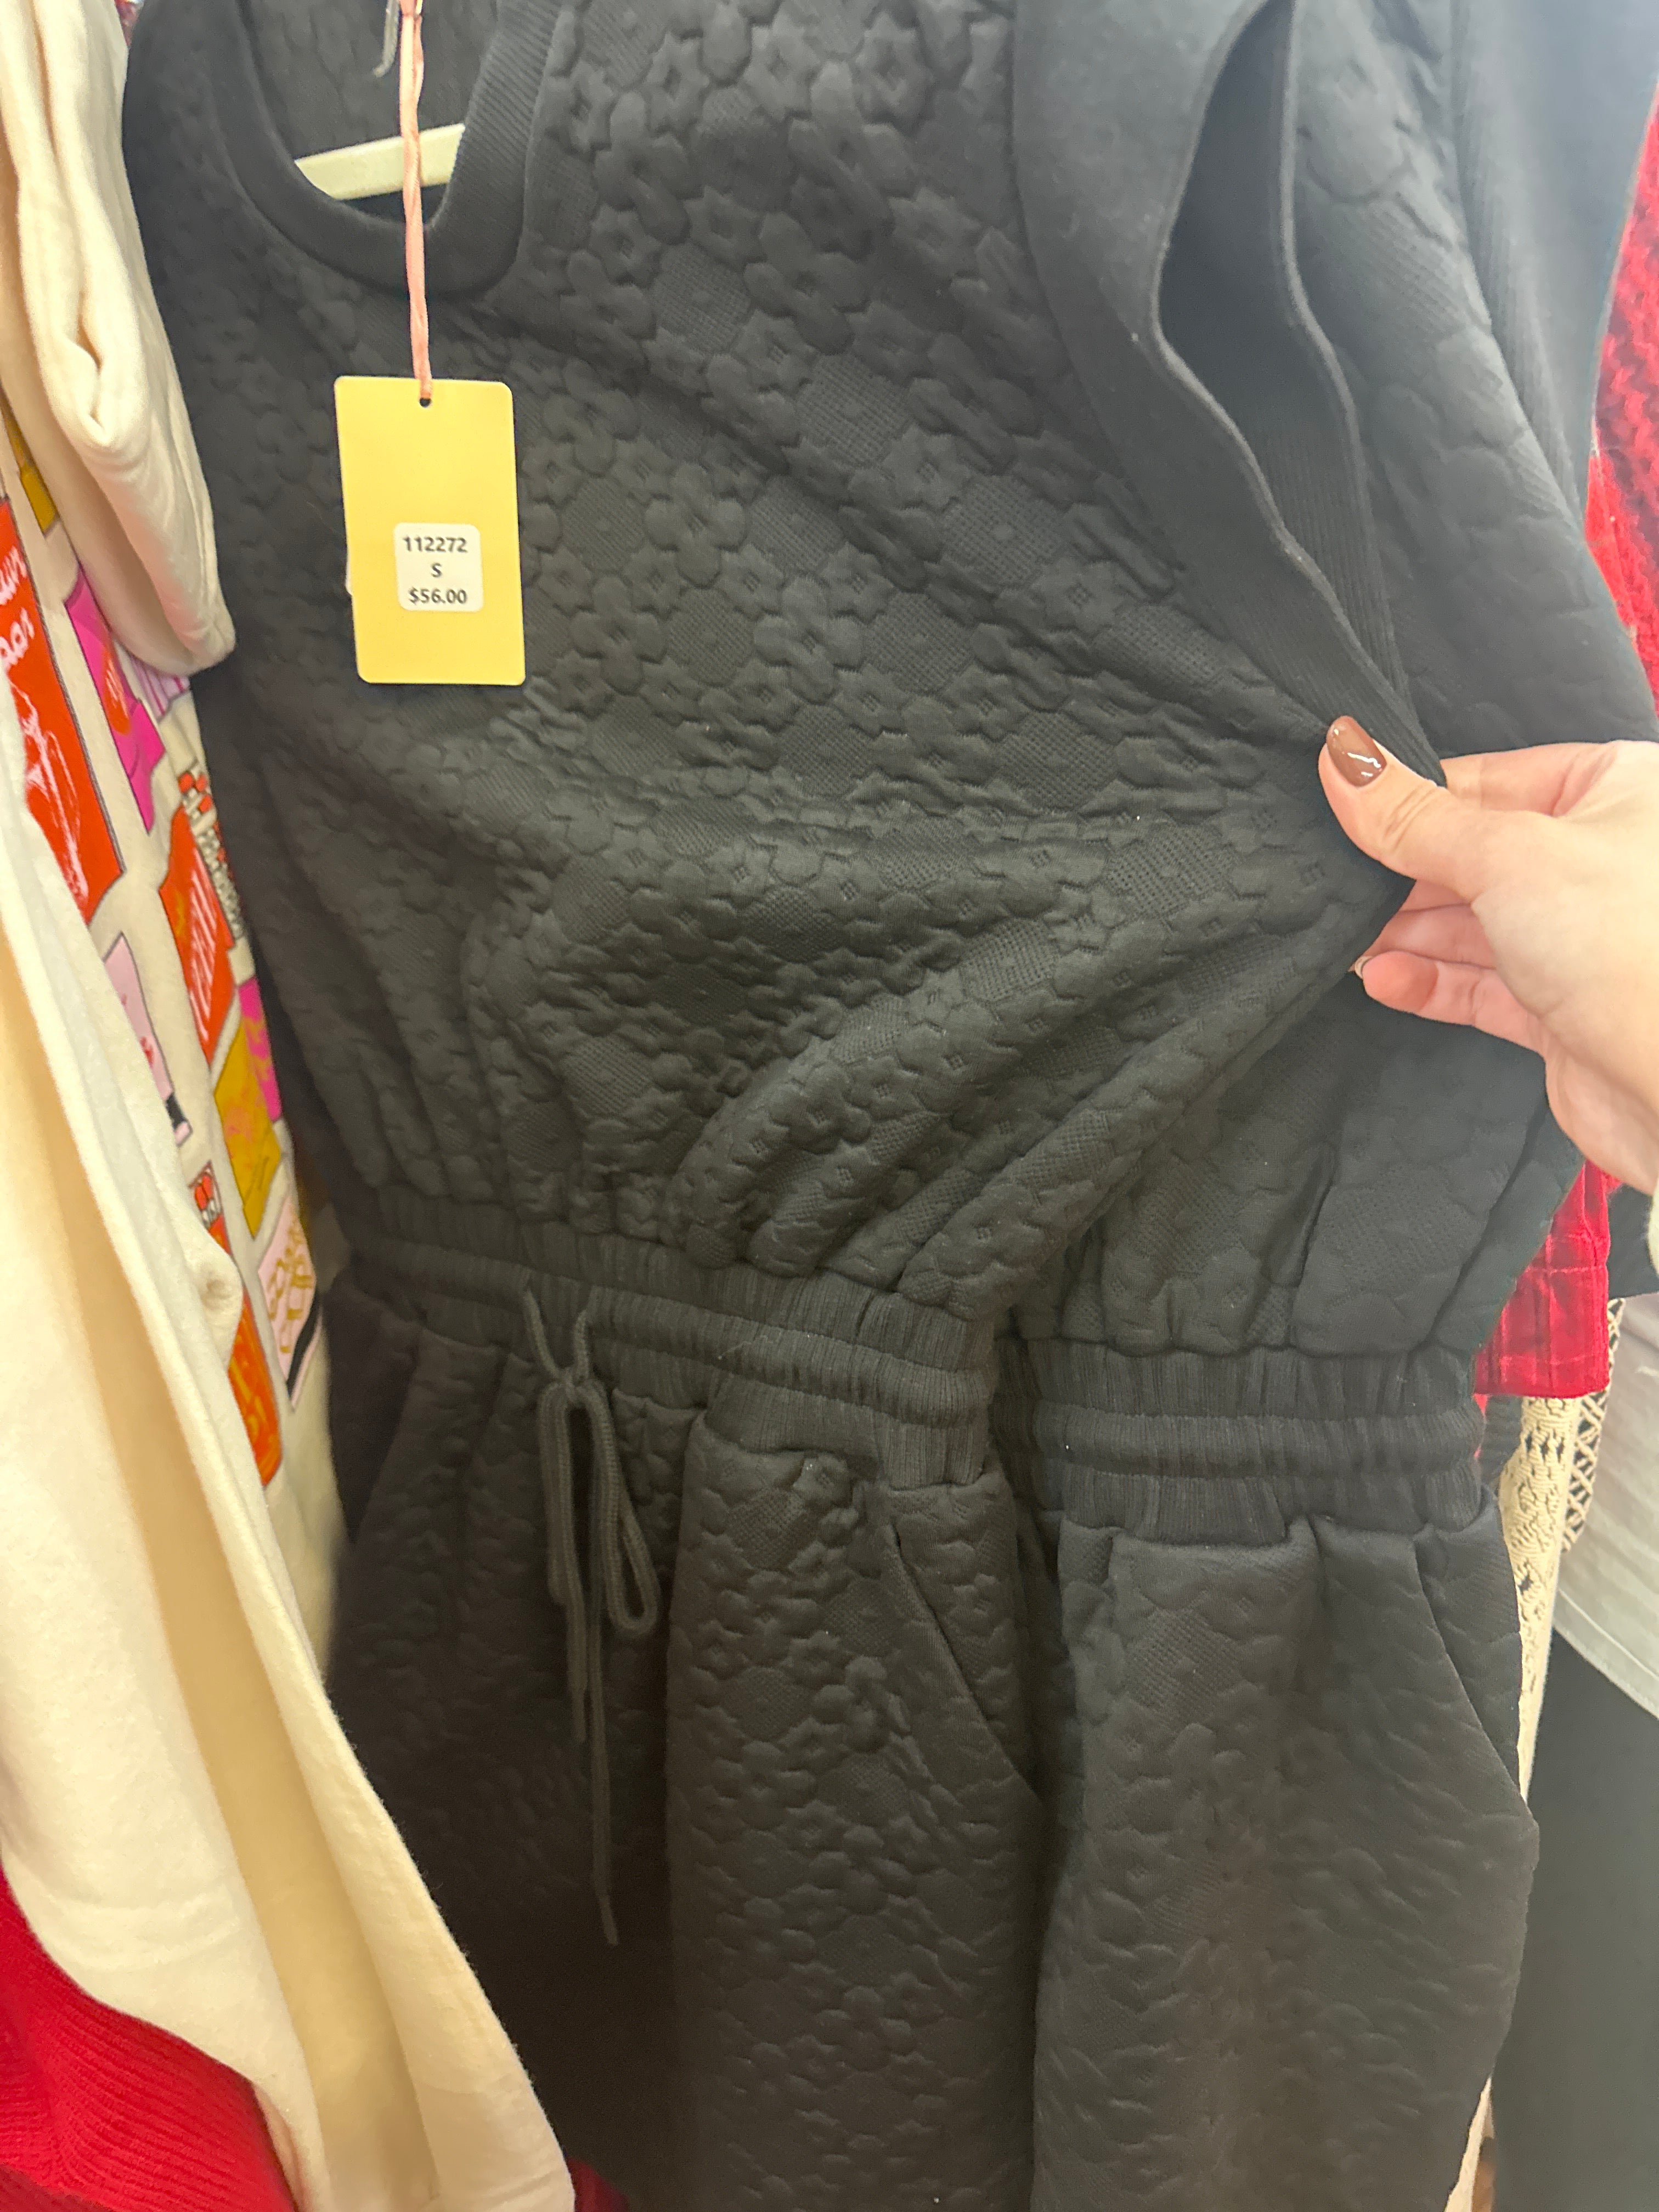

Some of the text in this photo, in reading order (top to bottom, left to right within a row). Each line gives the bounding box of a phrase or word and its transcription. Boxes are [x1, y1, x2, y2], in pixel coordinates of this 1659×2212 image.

[403, 535, 468, 553] 112272
[431, 562, 443, 578] S
[408, 586, 468, 605] $56.00
